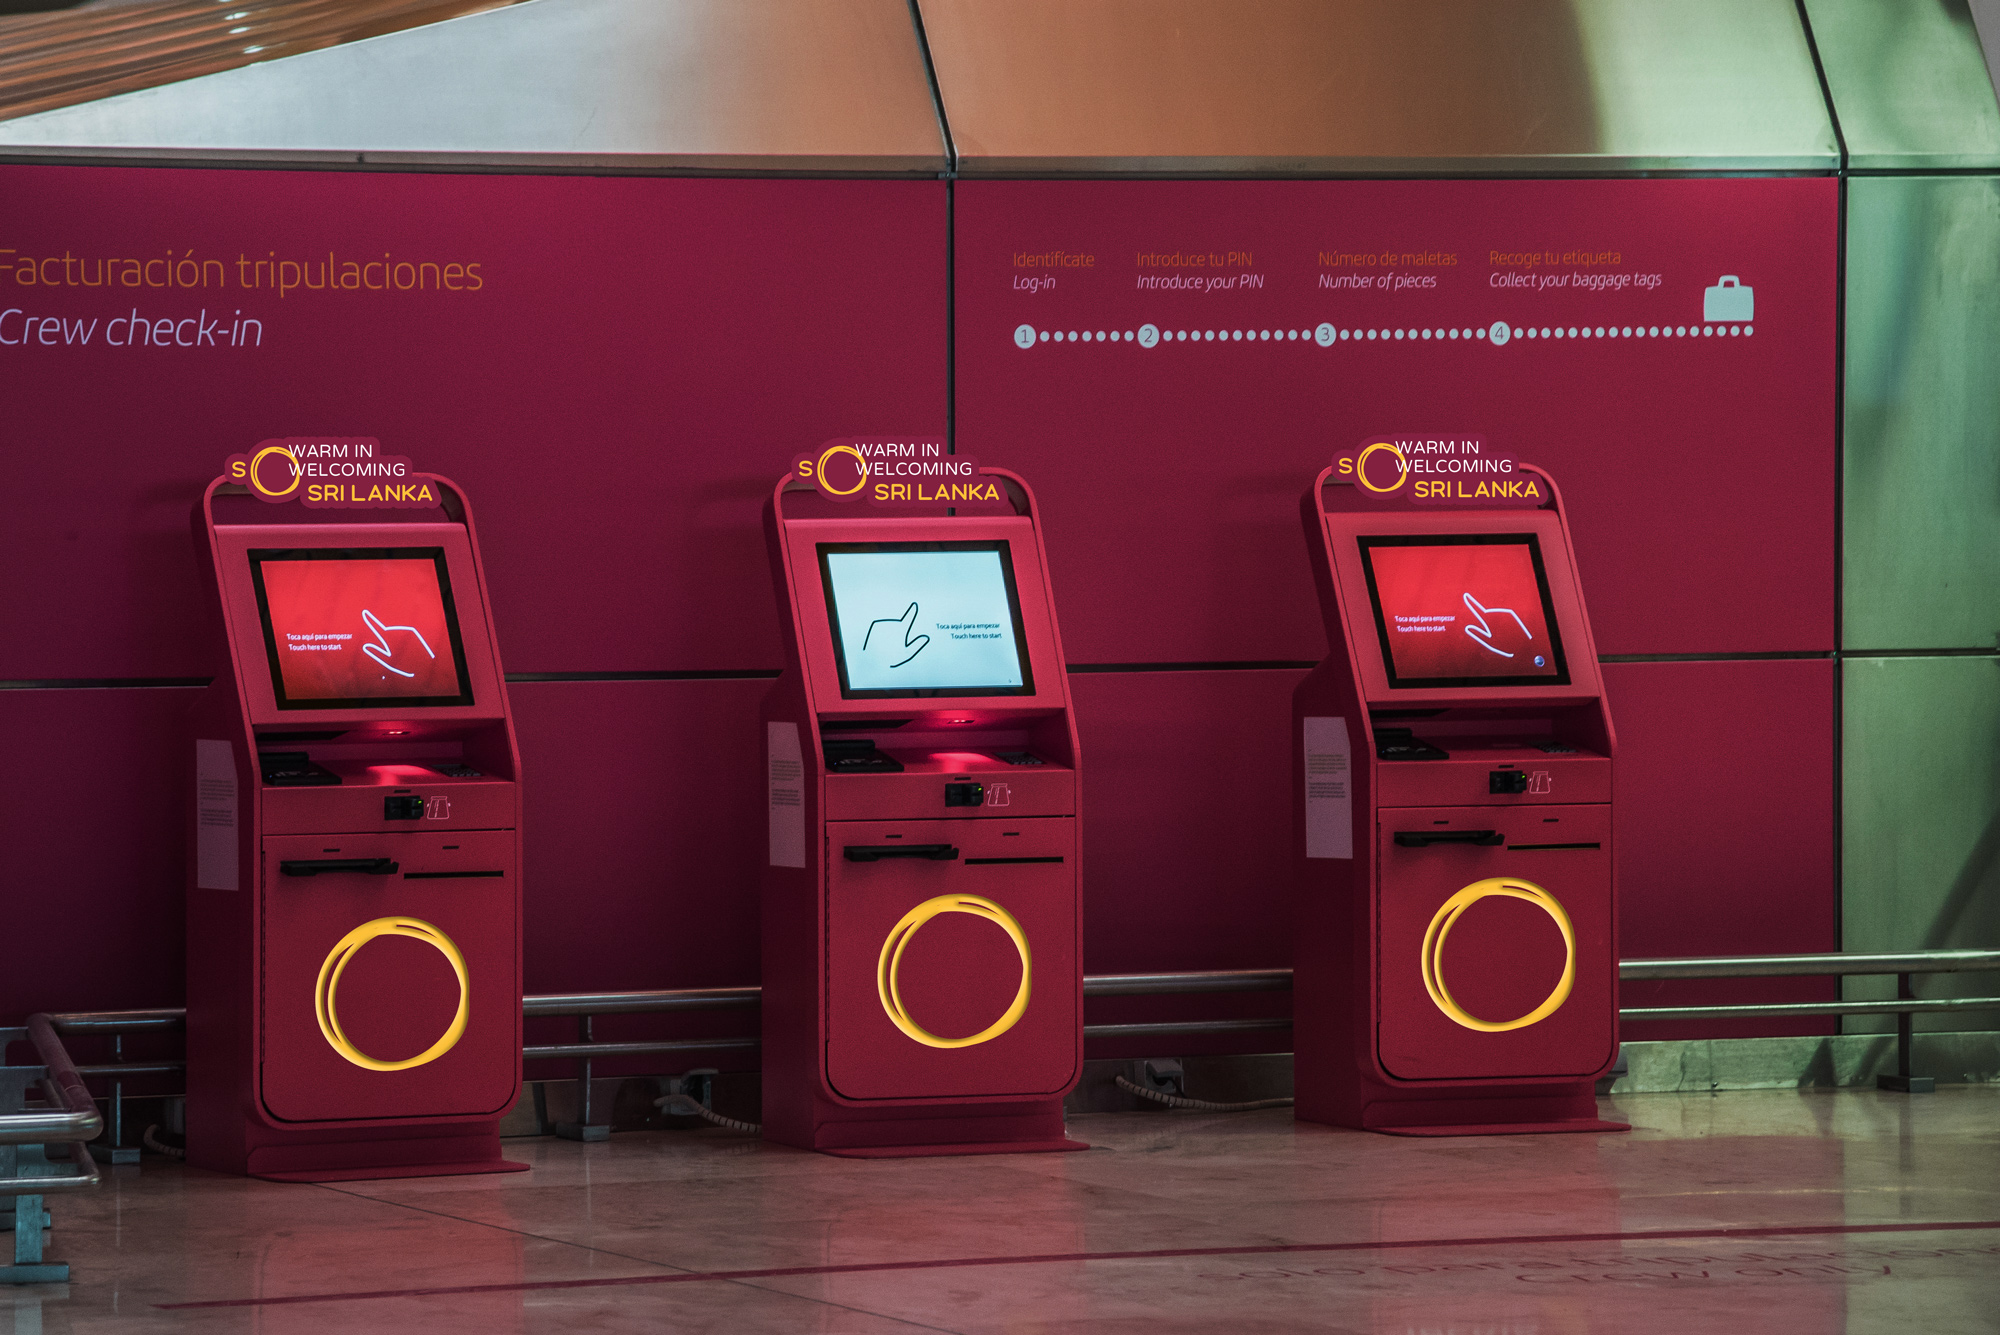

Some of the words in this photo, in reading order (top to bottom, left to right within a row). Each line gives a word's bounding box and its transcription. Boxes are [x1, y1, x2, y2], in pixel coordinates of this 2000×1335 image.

[1013, 250, 1095, 268] Identifícate
[1137, 251, 1206, 267] Introduce
[1209, 252, 1224, 267] tu
[1228, 251, 1253, 267] PIN
[1319, 250, 1377, 267] Número
[1380, 250, 1398, 266] de
[1401, 250, 1458, 266] maletas
[1489, 250, 1541, 269] Recoge
[1545, 250, 1560, 265] tu
[1563, 249, 1621, 268] etiqueta
[235, 251, 483, 299] tripulaciones
[1013, 274, 1056, 293] Log-in
[1137, 273, 1204, 289] Introduce
[1205, 276, 1238, 293] your
[1240, 273, 1265, 289] PIN
[1319, 272, 1375, 289] Number
[1377, 271, 1394, 291] of
[1394, 272, 1437, 292] pieces
[1489, 272, 1537, 288] Collect
[1537, 274, 1571, 292] your
[1572, 271, 1631, 291] baggage
[1633, 272, 1662, 290] tags
[0, 308, 98, 345] Crew
[106, 307, 262, 347] check-in
[288, 444, 348, 458] WARM
[355, 444, 372, 458] IN
[855, 443, 915, 457] WARM
[922, 443, 939, 457] IN
[1395, 440, 1455, 454] WARM
[1462, 440, 1479, 454] IN
[288, 463, 406, 477] WELCOMING
[855, 462, 972, 476] WELCOMING
[1395, 459, 1512, 473] WELCOMING
[308, 484, 344, 501] SRI
[351, 484, 433, 501] LANKA
[875, 483, 911, 500] SRI
[918, 483, 1000, 500] LANKA
[1414, 481, 1451, 498] SRI
[1458, 481, 1540, 498] LANKA
[1735, 1264, 1892, 1277] only
